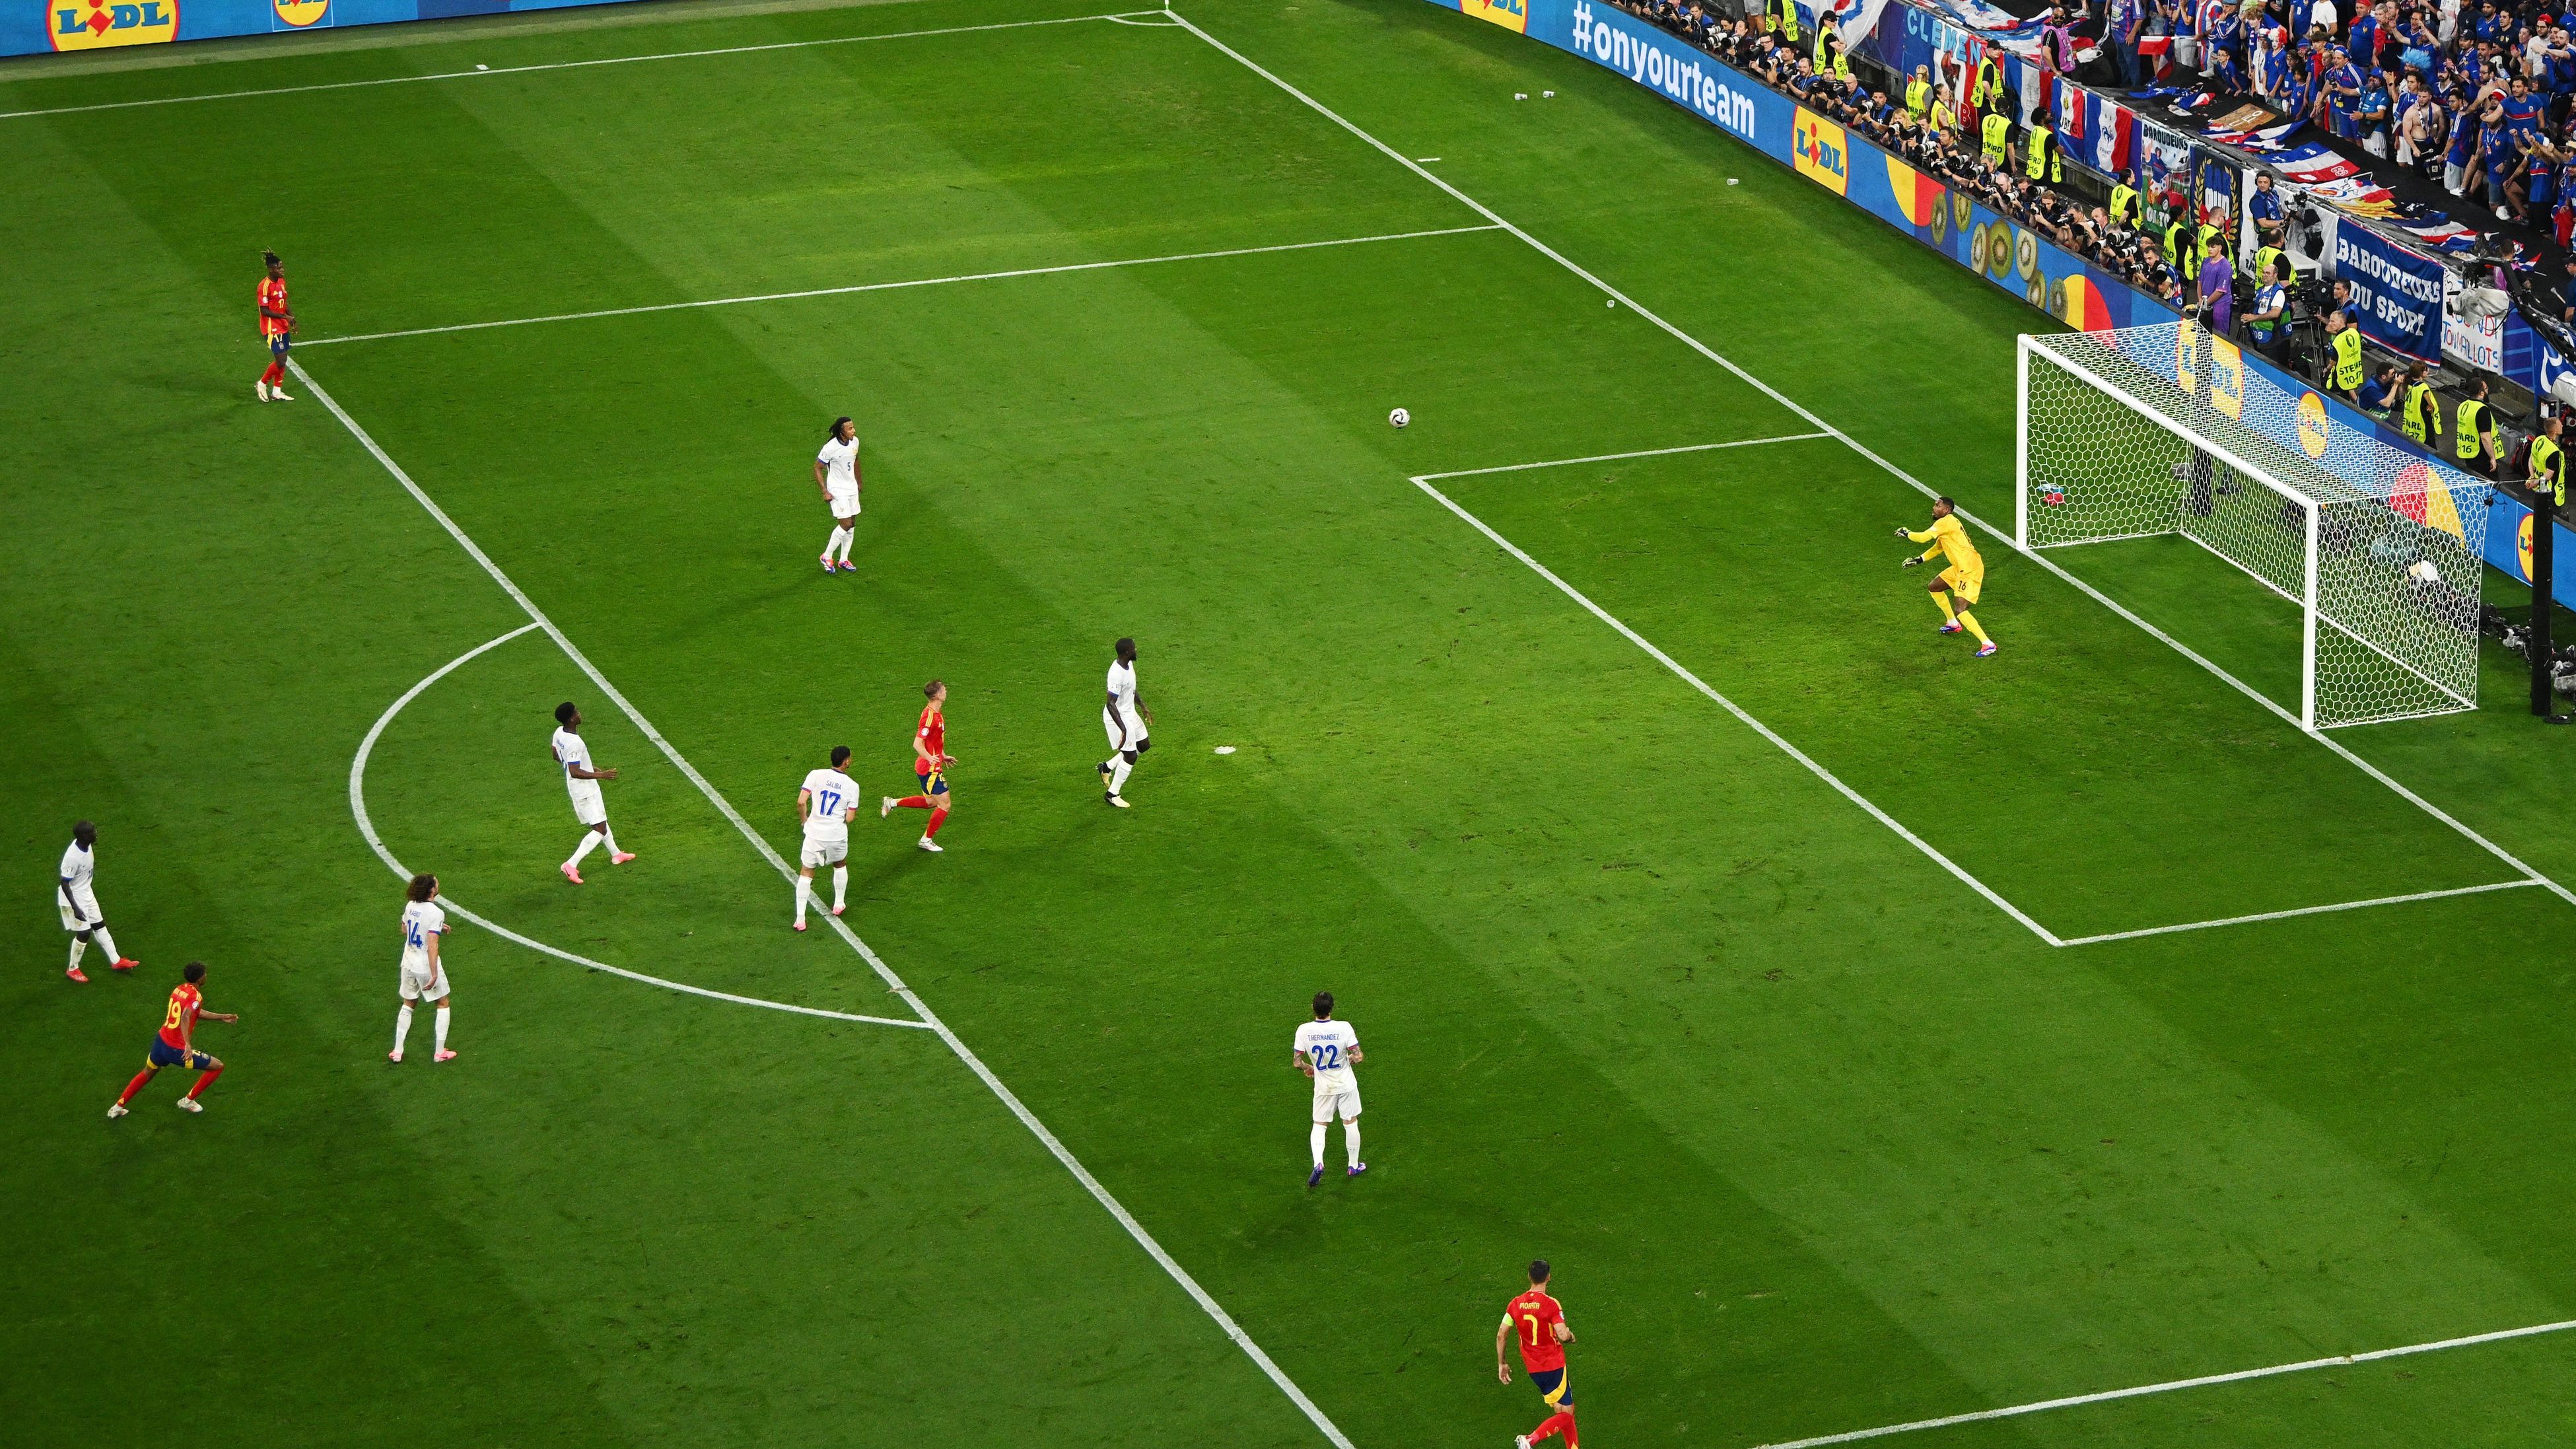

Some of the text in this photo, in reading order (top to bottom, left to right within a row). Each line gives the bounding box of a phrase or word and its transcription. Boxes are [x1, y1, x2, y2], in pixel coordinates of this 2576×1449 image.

[1907, 8, 1982, 68] CLEMEN
[1572, 0, 1755, 139] #onyourteam
[2143, 124, 2188, 151] BAROUDEURS
[2337, 236, 2441, 304] BAROUDEURS
[278, 299, 285, 308] 17
[2350, 280, 2373, 311] DU
[2376, 295, 2425, 337] SPORT
[847, 462, 851, 471] 5
[1958, 580, 1967, 591] 16
[825, 780, 842, 790] SALIBA
[819, 790, 842, 816] 17
[407, 919, 423, 948] 14
[164, 997, 182, 1029] 19
[1311, 1044, 1341, 1071] 22
[1523, 1314, 1538, 1346] 7
